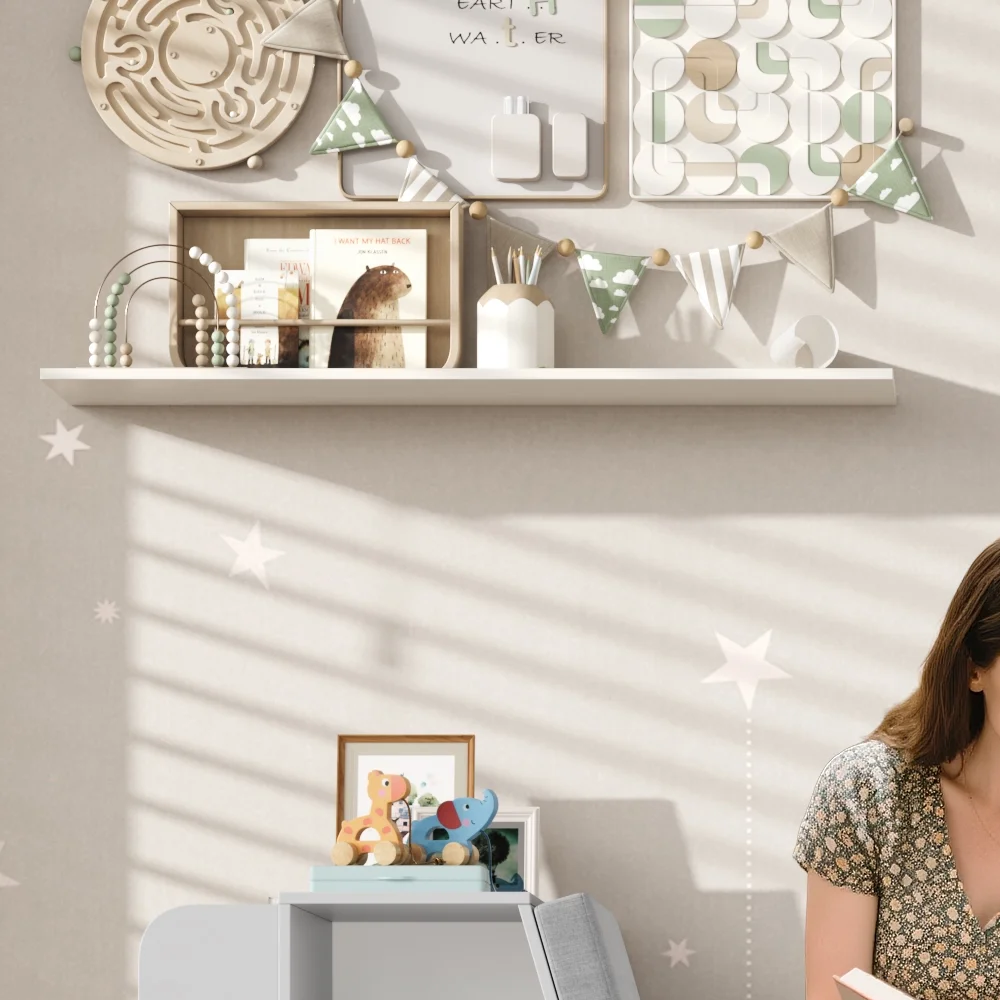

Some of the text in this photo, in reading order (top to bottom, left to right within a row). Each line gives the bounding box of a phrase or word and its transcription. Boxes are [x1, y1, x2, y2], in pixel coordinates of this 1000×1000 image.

[338, 237, 360, 245] WANT
[361, 237, 374, 245] MY
[375, 237, 390, 245] HAT
[391, 237, 412, 245] BACK
